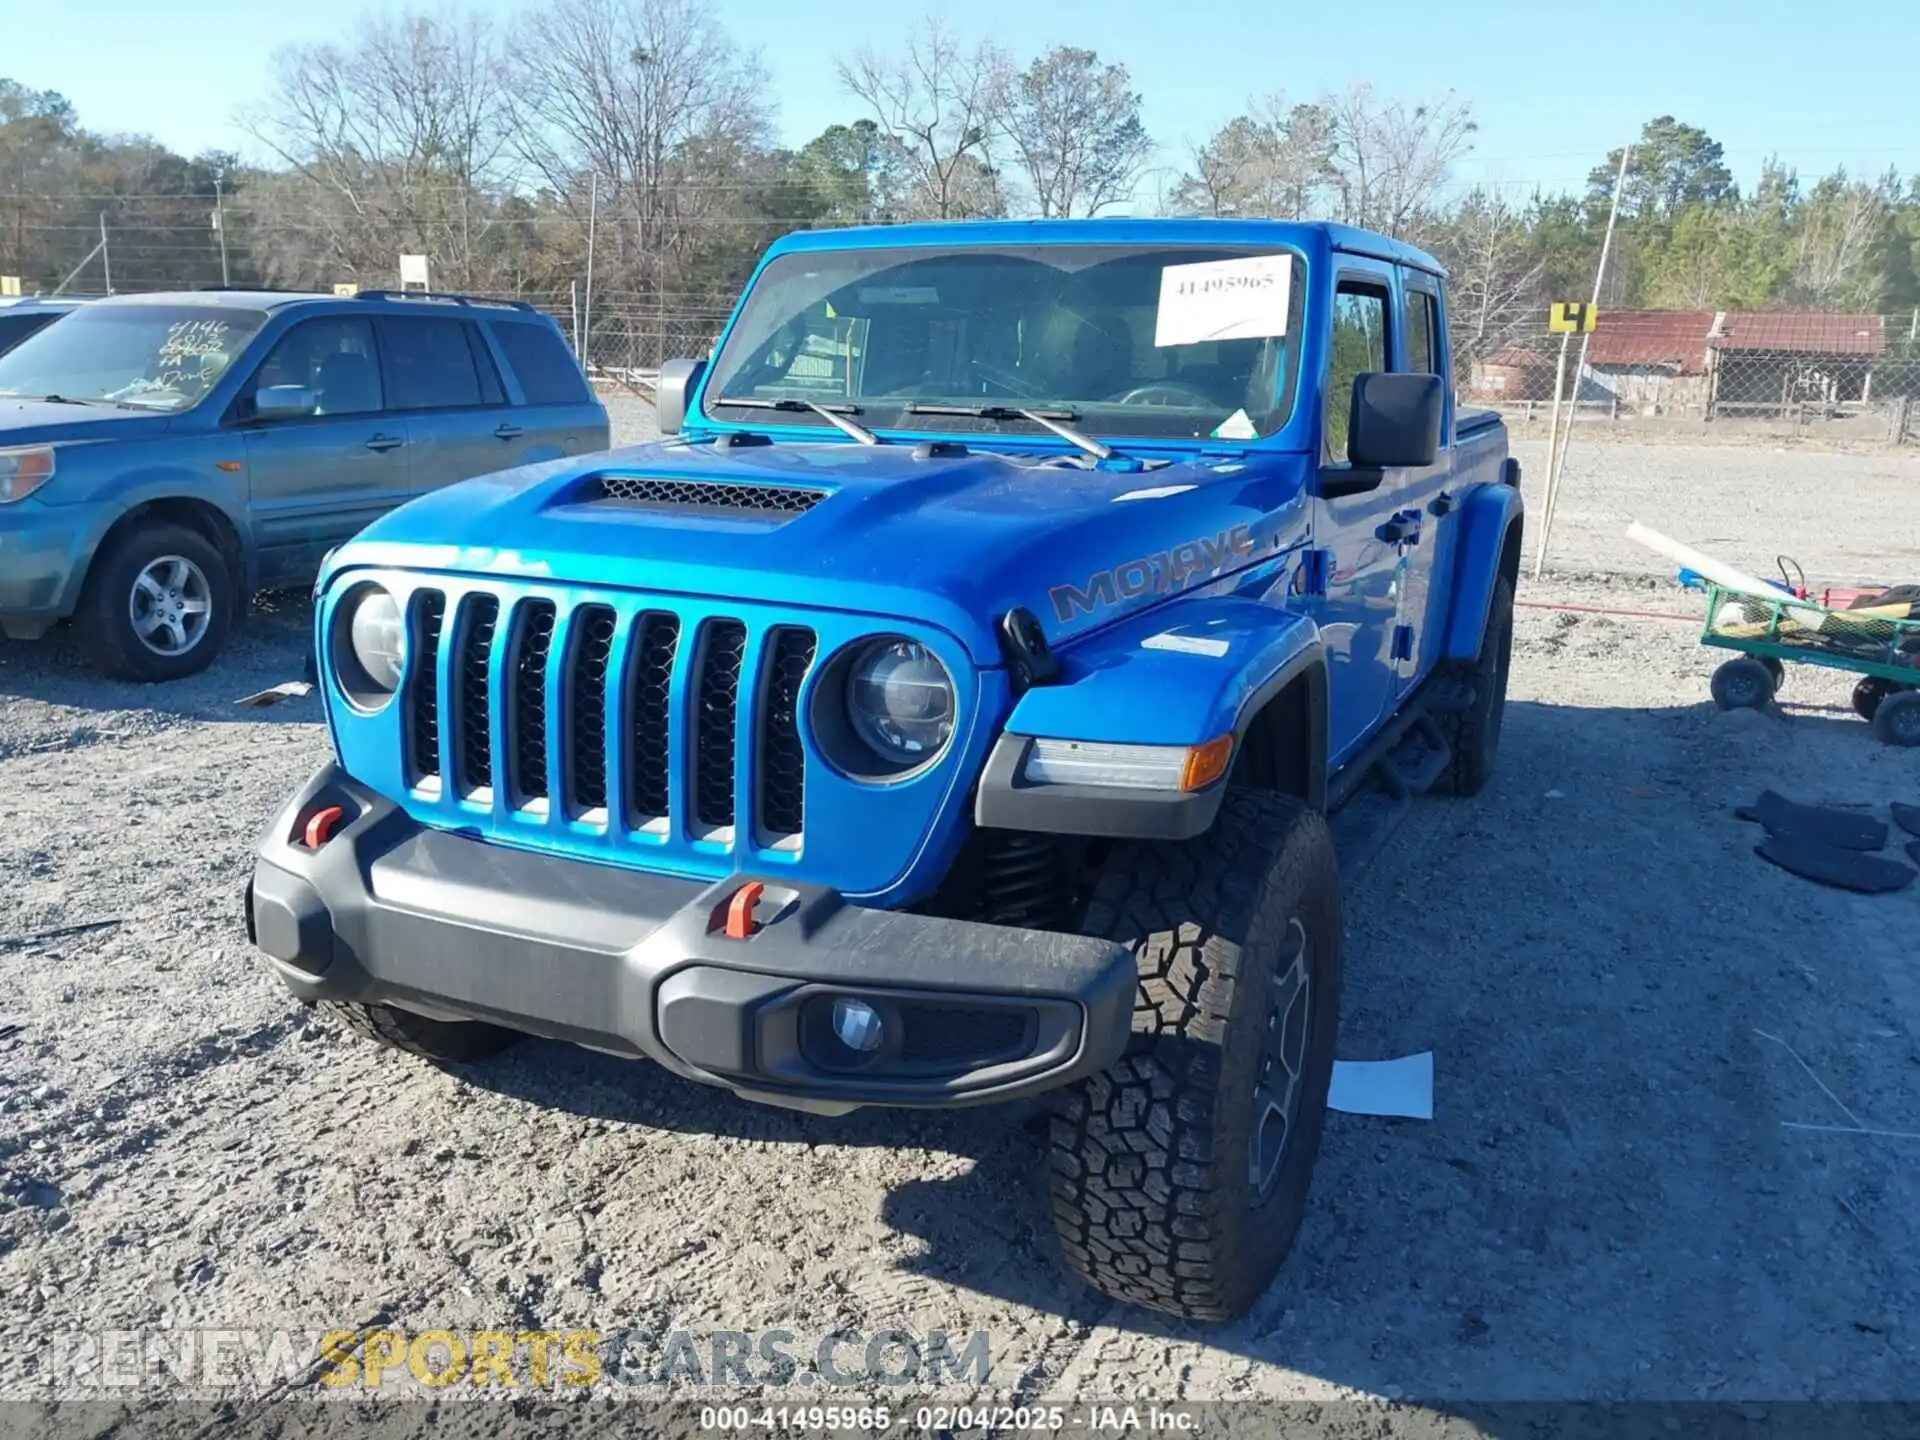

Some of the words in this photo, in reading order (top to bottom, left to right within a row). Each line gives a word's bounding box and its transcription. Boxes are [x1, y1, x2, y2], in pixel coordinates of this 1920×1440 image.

[1177, 273, 1274, 296] 41495965
[1563, 303, 1587, 332] 4
[1049, 524, 1254, 623] MOJAVE
